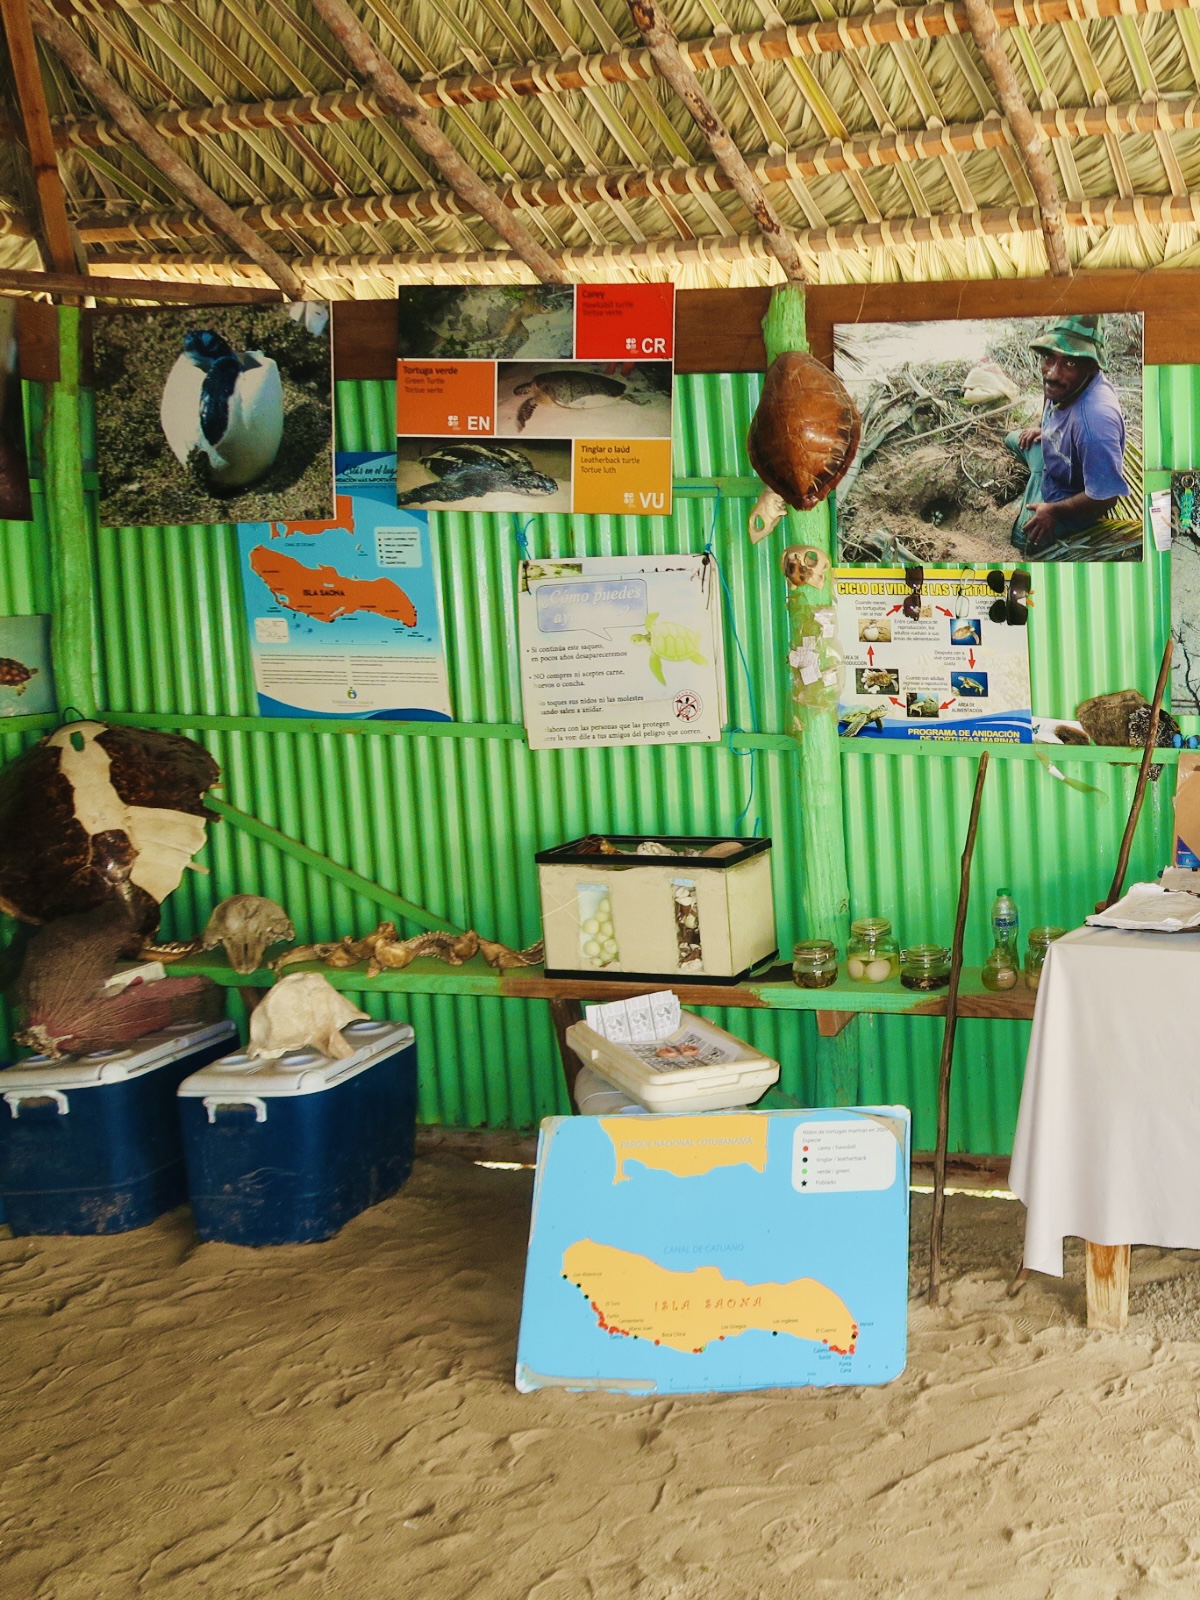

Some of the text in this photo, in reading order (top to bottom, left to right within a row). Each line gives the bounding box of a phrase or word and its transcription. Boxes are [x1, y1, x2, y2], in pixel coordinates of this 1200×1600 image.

[582, 289, 605, 299] Carey
[641, 337, 666, 354] CR
[403, 366, 458, 376] Tortuga verde
[468, 416, 490, 431] EN
[581, 445, 606, 455] Tinglar
[614, 445, 630, 454] laúd
[581, 457, 640, 465] Leatherback turtle
[639, 493, 664, 509] VU
[837, 582, 950, 596] CICLO DE VIDA LAS
[542, 584, 640, 608] ¿Cómo puedes
[540, 655, 558, 664] pocos
[575, 651, 627, 661] desapareceremos
[546, 672, 573, 681] compres
[582, 670, 604, 679] aceptes
[547, 699, 567, 707] toques
[590, 723, 617, 732] personas
[619, 723, 631, 731] que
[643, 721, 670, 729] protegen
[608, 732, 630, 740] amigos
[643, 730, 665, 739] peligro
[908, 728, 1020, 738] PROGRAMA DE ANIDACIÓN
[620, 1140, 652, 1148] PARQUE
[654, 1139, 694, 1147] NACIONAL
[663, 1245, 690, 1254] CANAL
[692, 1245, 703, 1253] DE
[654, 1296, 762, 1312] ISLA SAONA
